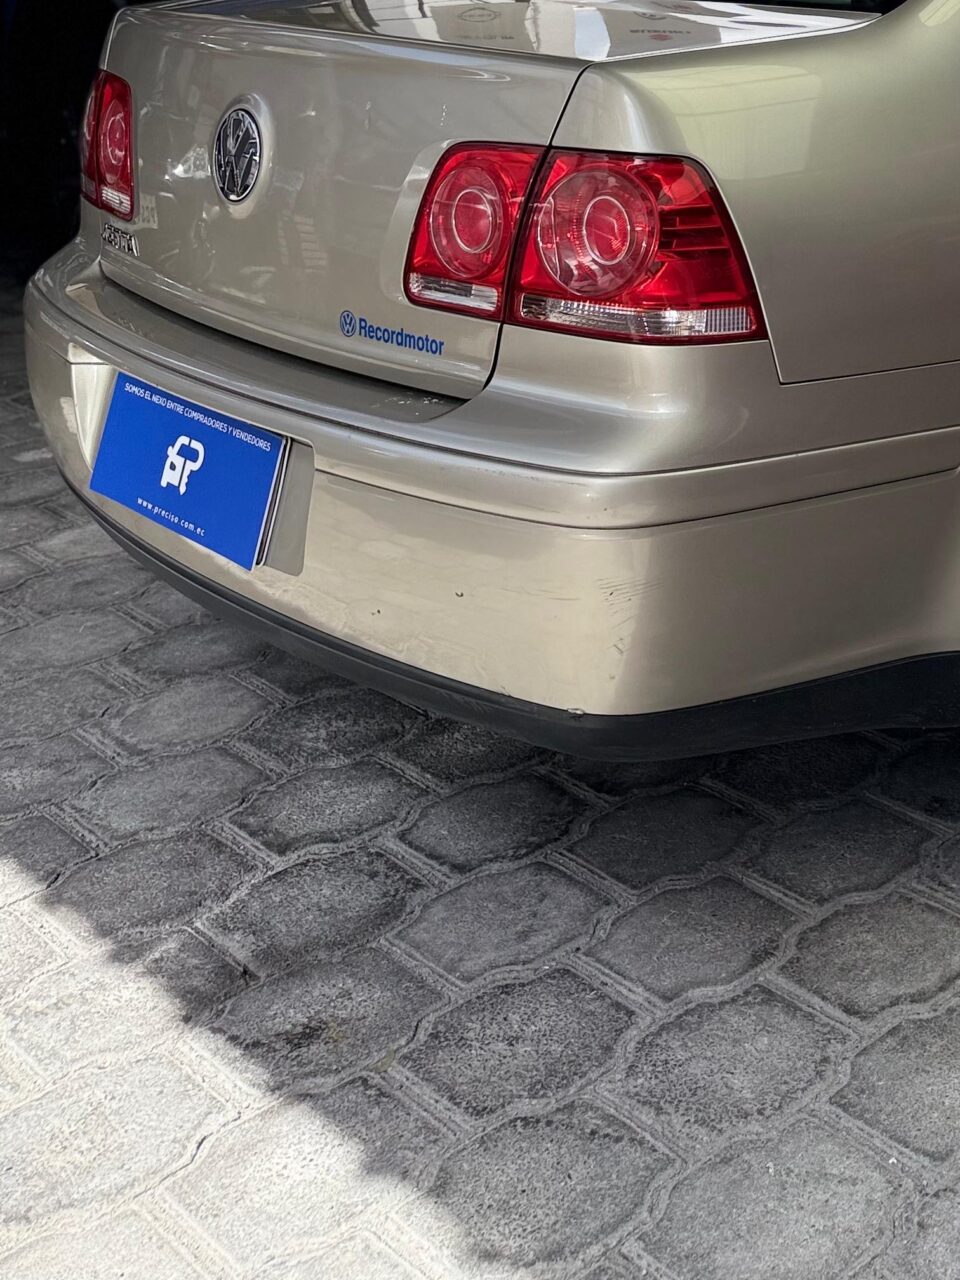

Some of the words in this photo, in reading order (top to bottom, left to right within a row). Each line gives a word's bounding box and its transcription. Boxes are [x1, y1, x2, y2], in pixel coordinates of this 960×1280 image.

[358, 317, 444, 355] Recordmotor
[124, 382, 145, 398] SOMOS
[144, 389, 152, 401] EL
[151, 392, 167, 407] NEXO
[166, 398, 184, 414] ENTRE
[184, 407, 228, 433] COMPRADORES
[227, 425, 233, 434] Y
[232, 427, 271, 452] VENDEDORES
[137, 496, 205, 537] www.preciso.com.ec
